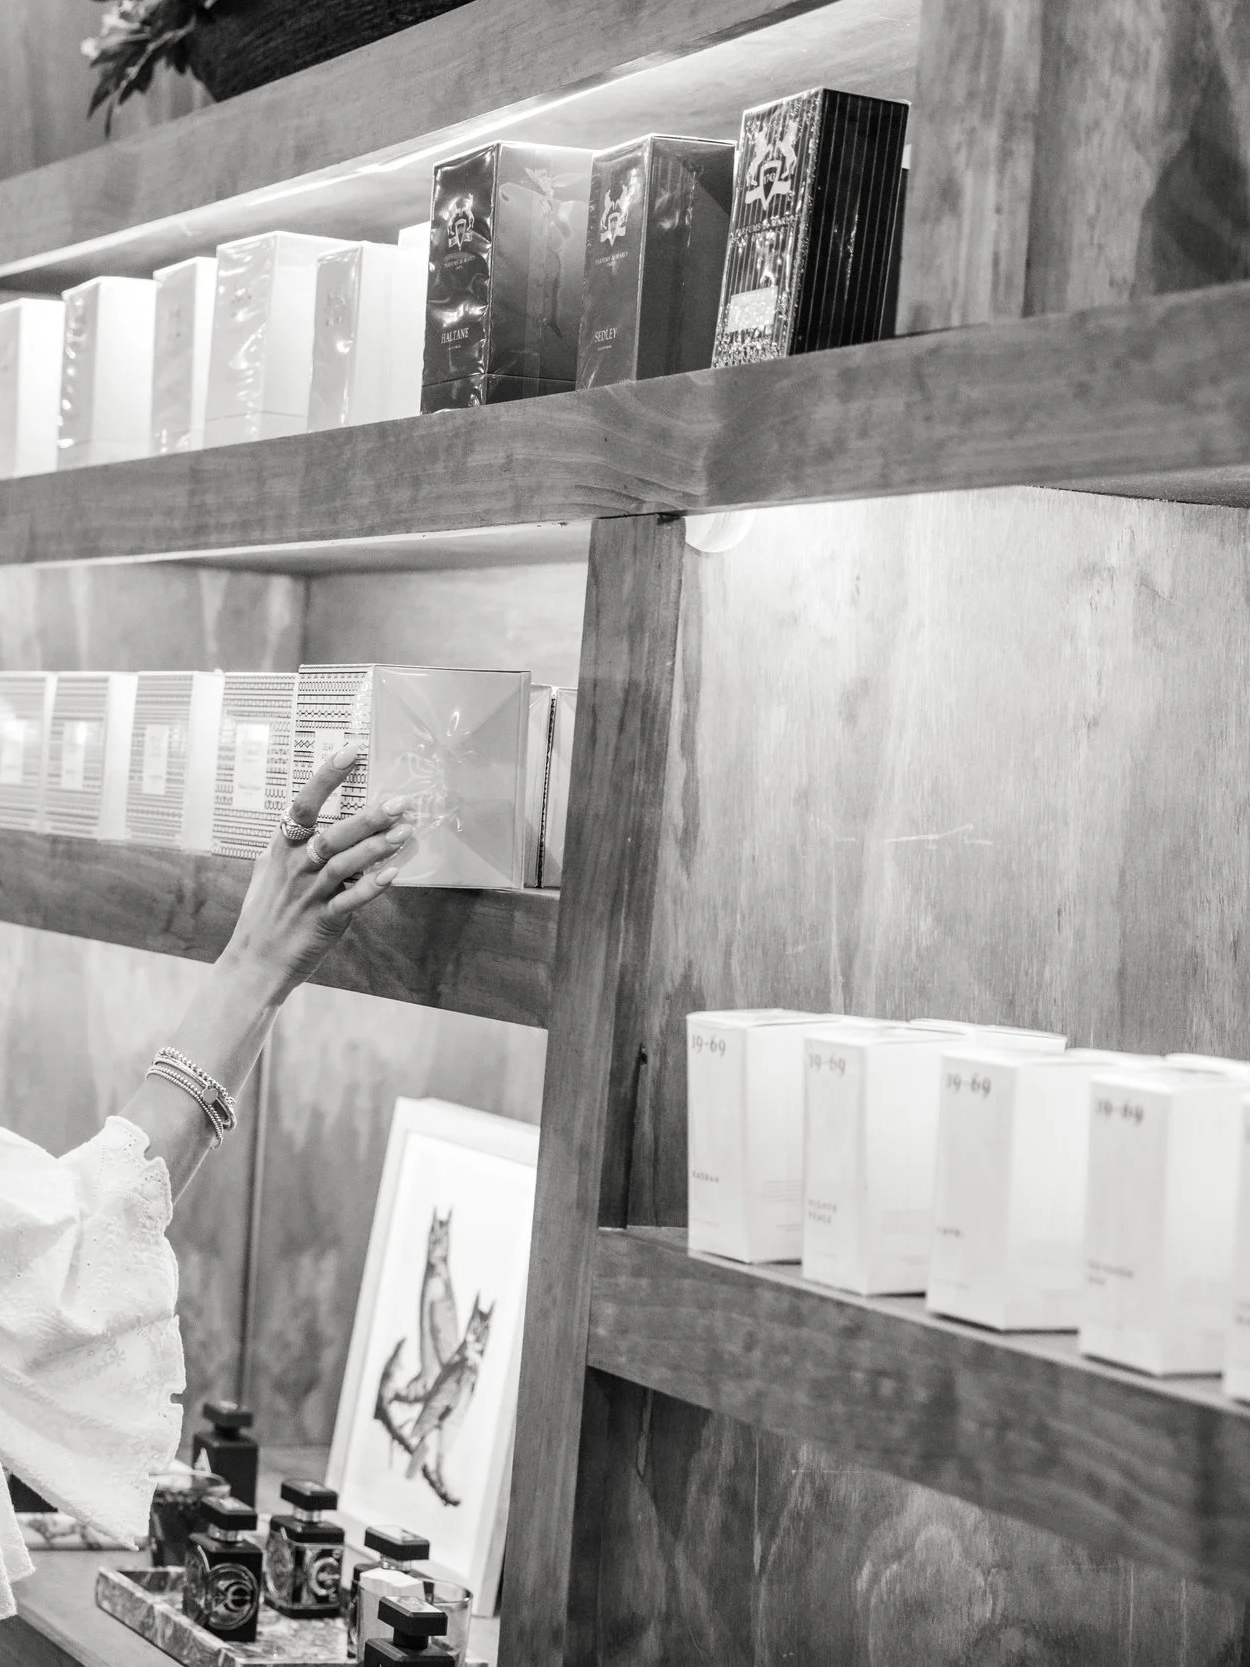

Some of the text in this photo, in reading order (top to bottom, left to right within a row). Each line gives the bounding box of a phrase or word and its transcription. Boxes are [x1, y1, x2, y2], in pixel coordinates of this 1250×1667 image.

[440, 327, 469, 344] HALTANE
[594, 327, 618, 343] SEDLEY
[691, 1032, 726, 1058] 19-69
[808, 1051, 846, 1079] 19-69
[946, 1071, 992, 1100] 19-69
